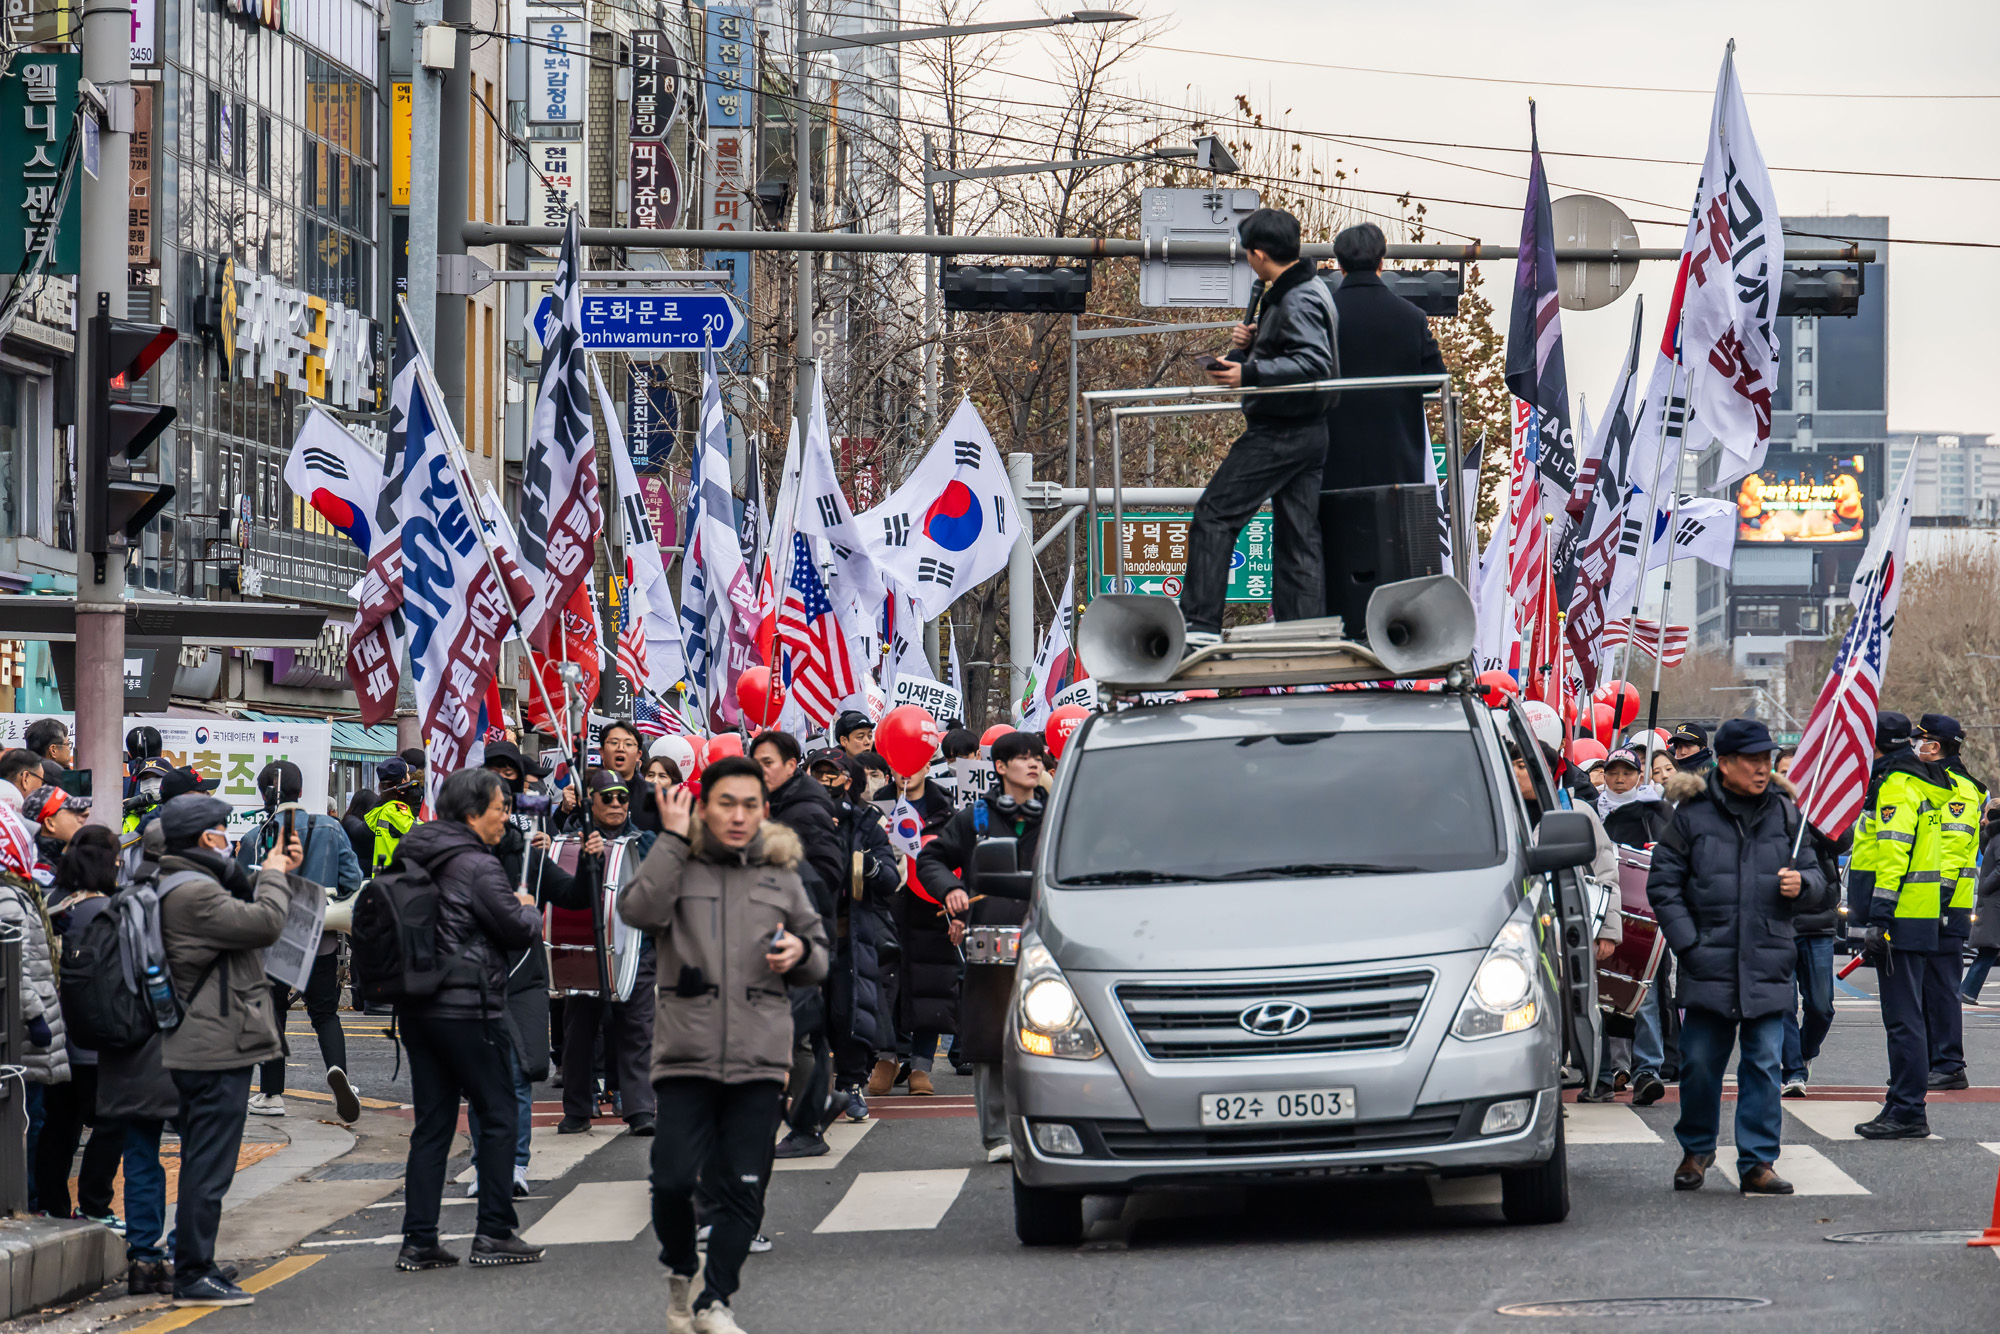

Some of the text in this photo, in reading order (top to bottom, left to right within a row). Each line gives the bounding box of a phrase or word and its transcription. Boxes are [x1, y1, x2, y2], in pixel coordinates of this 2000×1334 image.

[546, 24, 567, 58] 우리
[130, 47, 152, 61] 3450
[543, 57, 571, 70] 보석
[717, 17, 741, 116] 진전양행
[547, 72, 570, 119] 감정원
[635, 34, 660, 133] 피카커플링
[21, 63, 58, 264] 웰니스센터
[544, 147, 568, 173] 현대
[540, 175, 572, 188] 보석
[635, 145, 659, 229] 피카쥬얼
[585, 300, 682, 325] 돈화문로
[702, 313, 724, 332] 20
[582, 329, 698, 344] onhwamun-ro
[1124, 560, 1188, 575] hangdeokgung
[128, 678, 141, 690] 종로
[897, 680, 958, 710] 이재명을
[1060, 718, 1083, 727] FREE
[213, 731, 256, 743] 국가데이터처
[1214, 1091, 1342, 1121] 82수 0503
